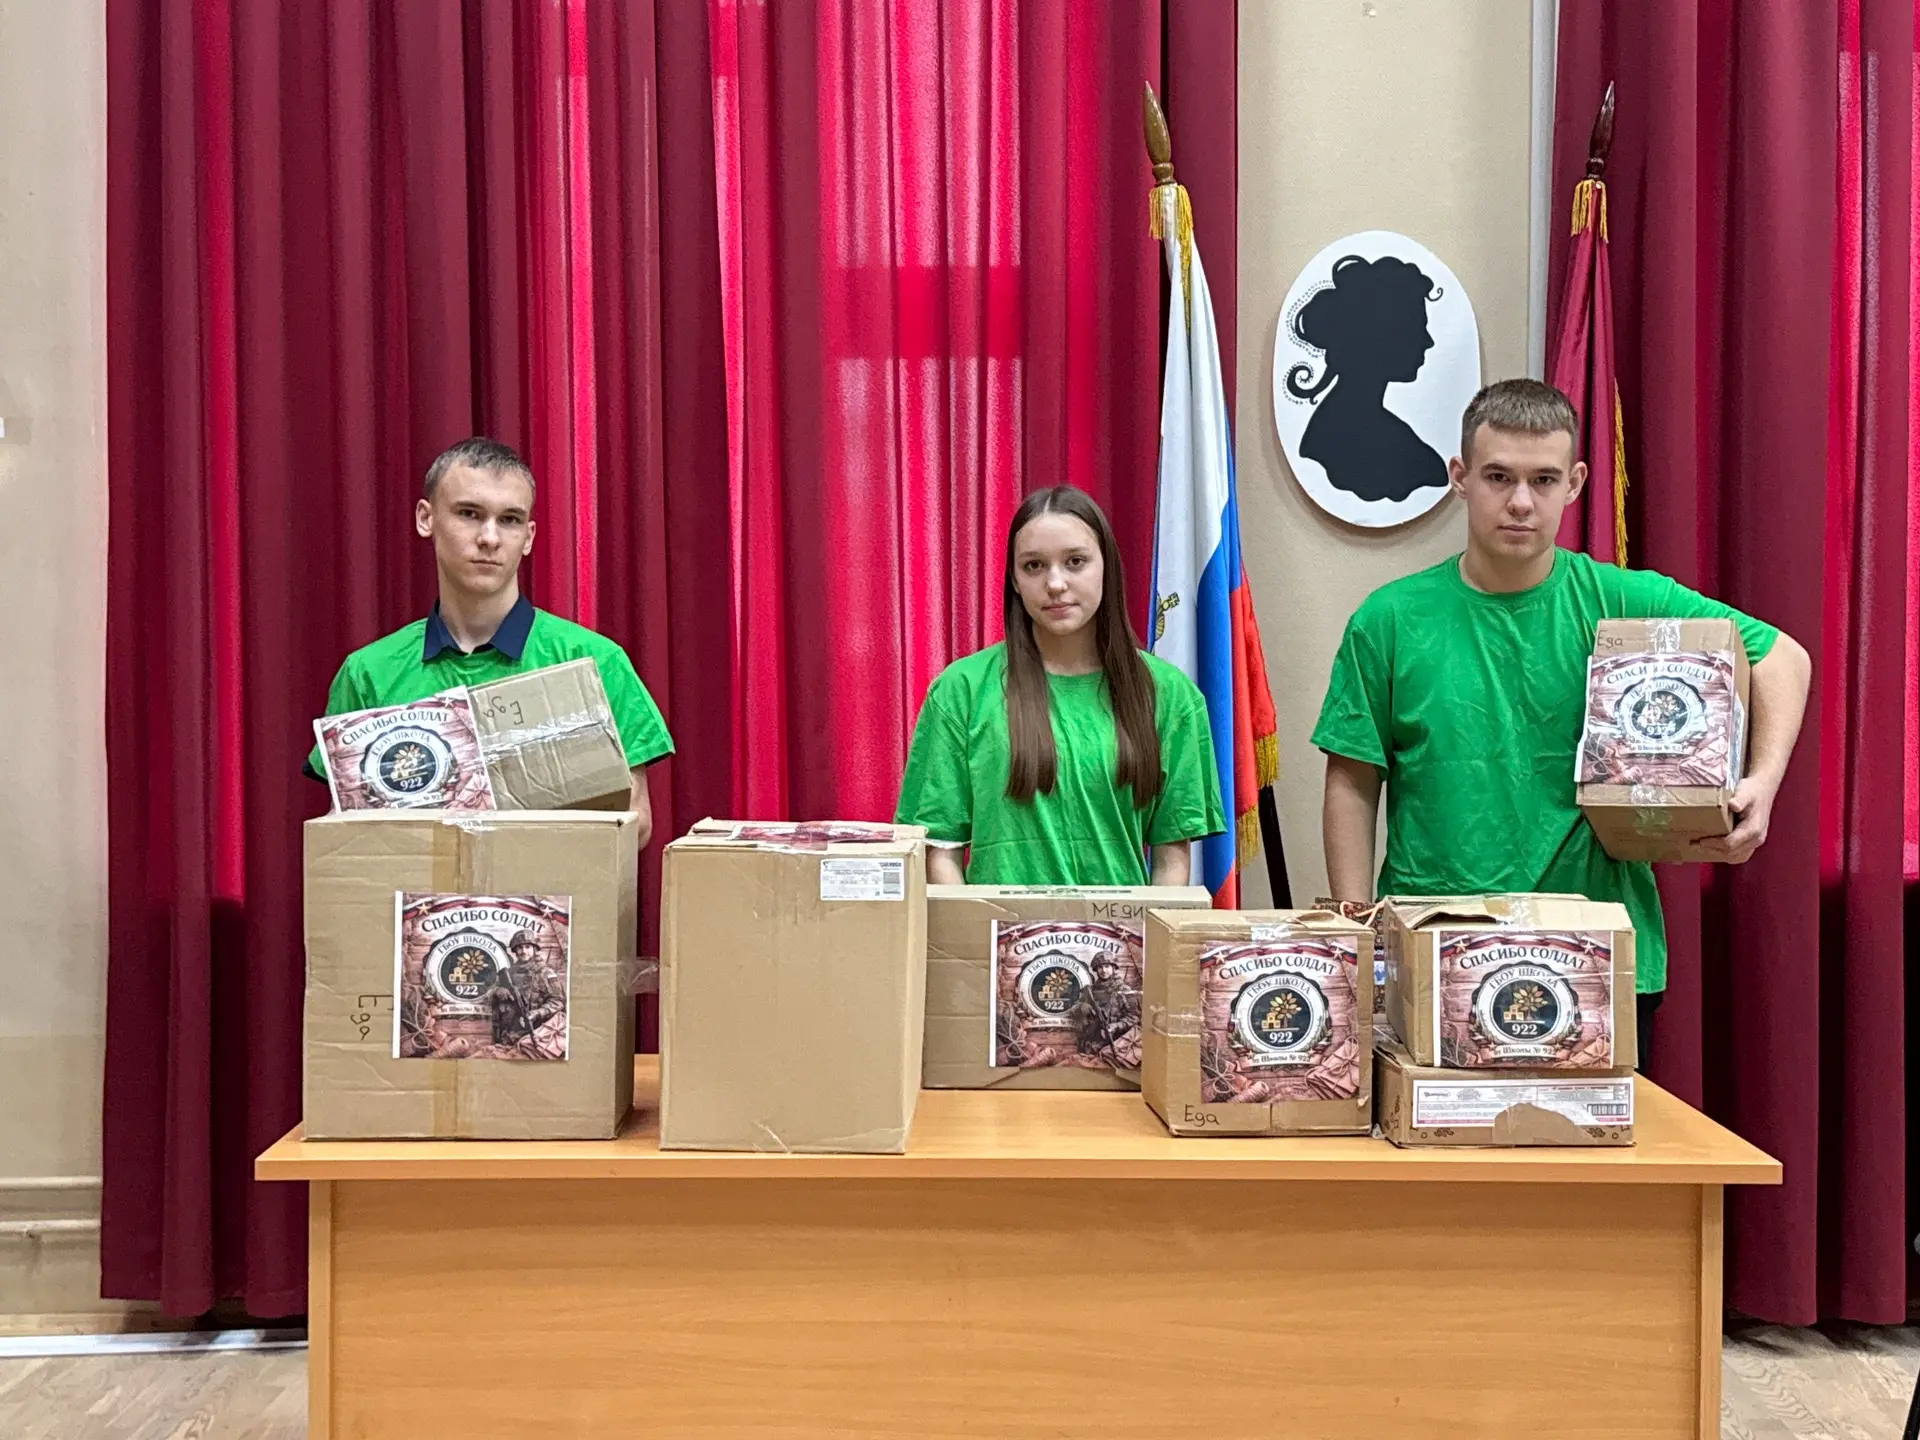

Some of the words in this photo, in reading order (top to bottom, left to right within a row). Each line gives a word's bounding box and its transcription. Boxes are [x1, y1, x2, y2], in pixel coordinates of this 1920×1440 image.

[1667, 663, 1713, 682] СОЛДАТ
[342, 714, 398, 745] СПАСИБО
[400, 709, 448, 723] СОЛДАТ
[399, 776, 424, 791] 922
[421, 909, 488, 933] СПАСИБО
[491, 909, 546, 934] СОЛДАТ
[437, 936, 460, 954] ГБОУ
[463, 935, 498, 953] ШКОЛА
[1014, 934, 1071, 956] СПАСИБО
[1074, 934, 1123, 954] СОЛДАТ
[1027, 958, 1048, 975] ГБОУ
[1050, 957, 1080, 973] ШКОЛА
[1219, 956, 1282, 980] СПАСИБО
[1286, 955, 1337, 975] СОЛДАТ
[1459, 947, 1527, 970] СПАСИБО
[1530, 946, 1588, 970] СОЛДАТ
[1247, 979, 1272, 998] ГБОУ
[1275, 977, 1311, 994] ШКОЛА
[1489, 968, 1515, 989] ГБОУ
[455, 985, 479, 995] 922
[1044, 1001, 1065, 1010] 922
[1269, 1031, 1294, 1043] 922
[1511, 1023, 1538, 1036] 922
[1502, 1046, 1531, 1054] Школы
